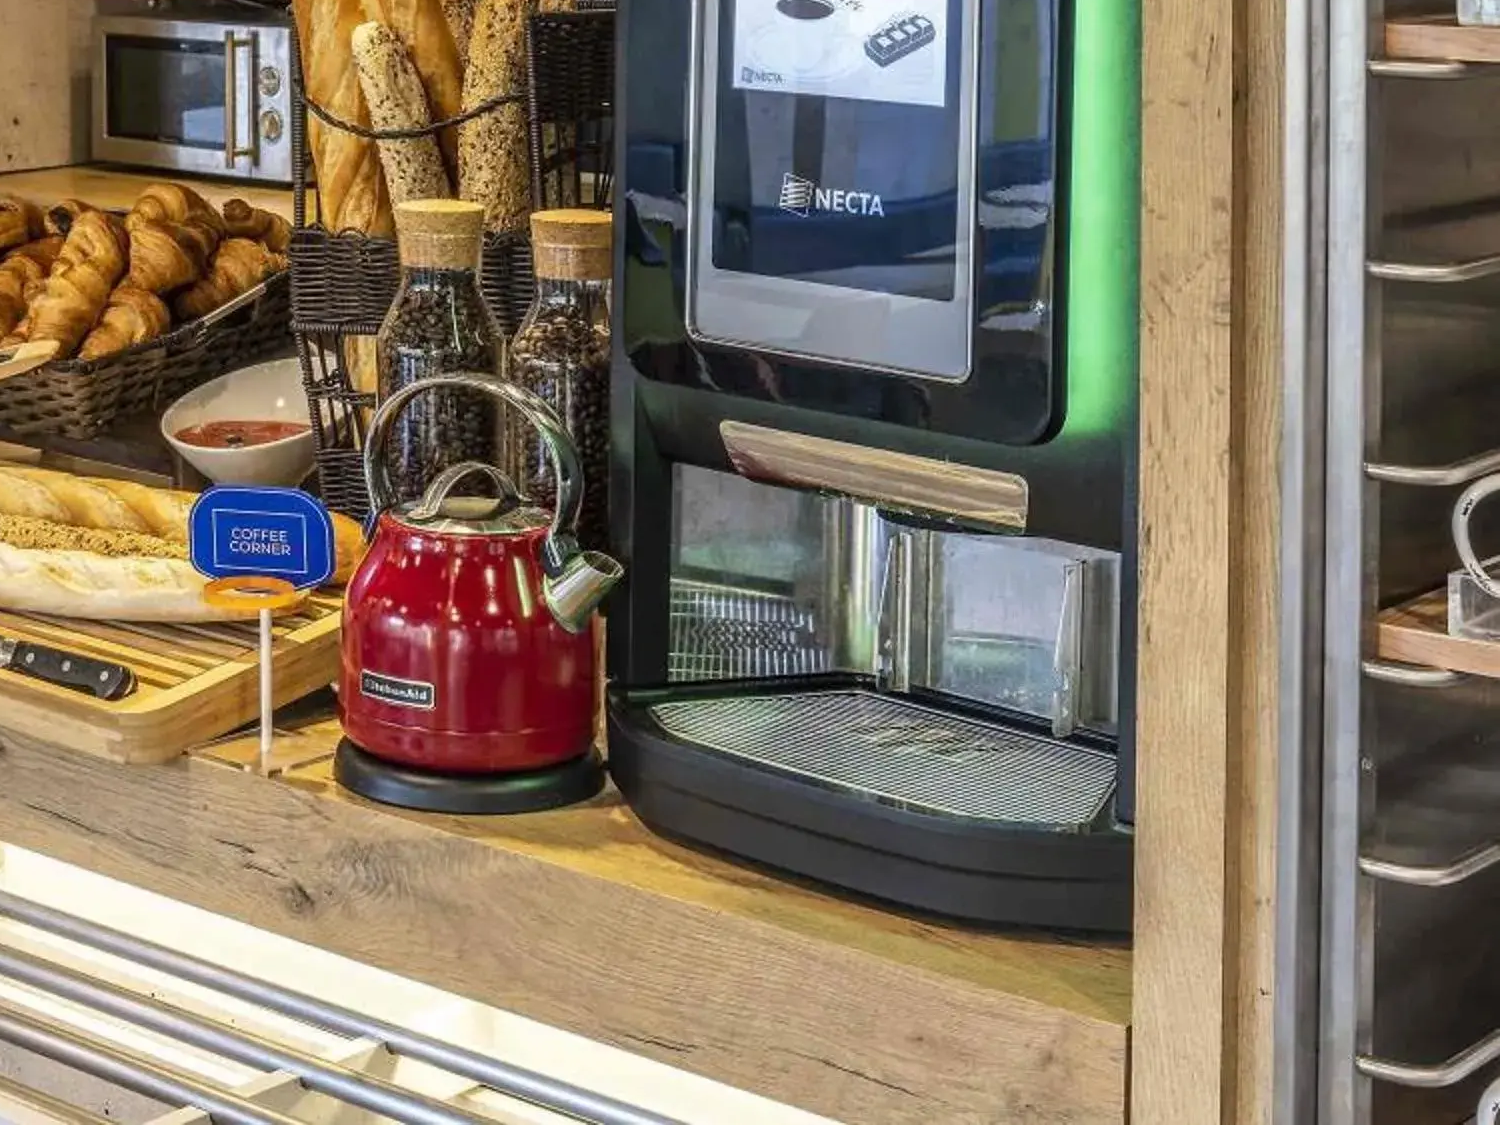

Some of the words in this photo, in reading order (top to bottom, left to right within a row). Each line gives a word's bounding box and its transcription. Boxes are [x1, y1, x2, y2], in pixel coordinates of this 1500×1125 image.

[754, 71, 784, 84] NECTA
[815, 187, 885, 218] NECTA
[230, 526, 289, 543] COFFEE
[229, 539, 292, 556] CORNER
